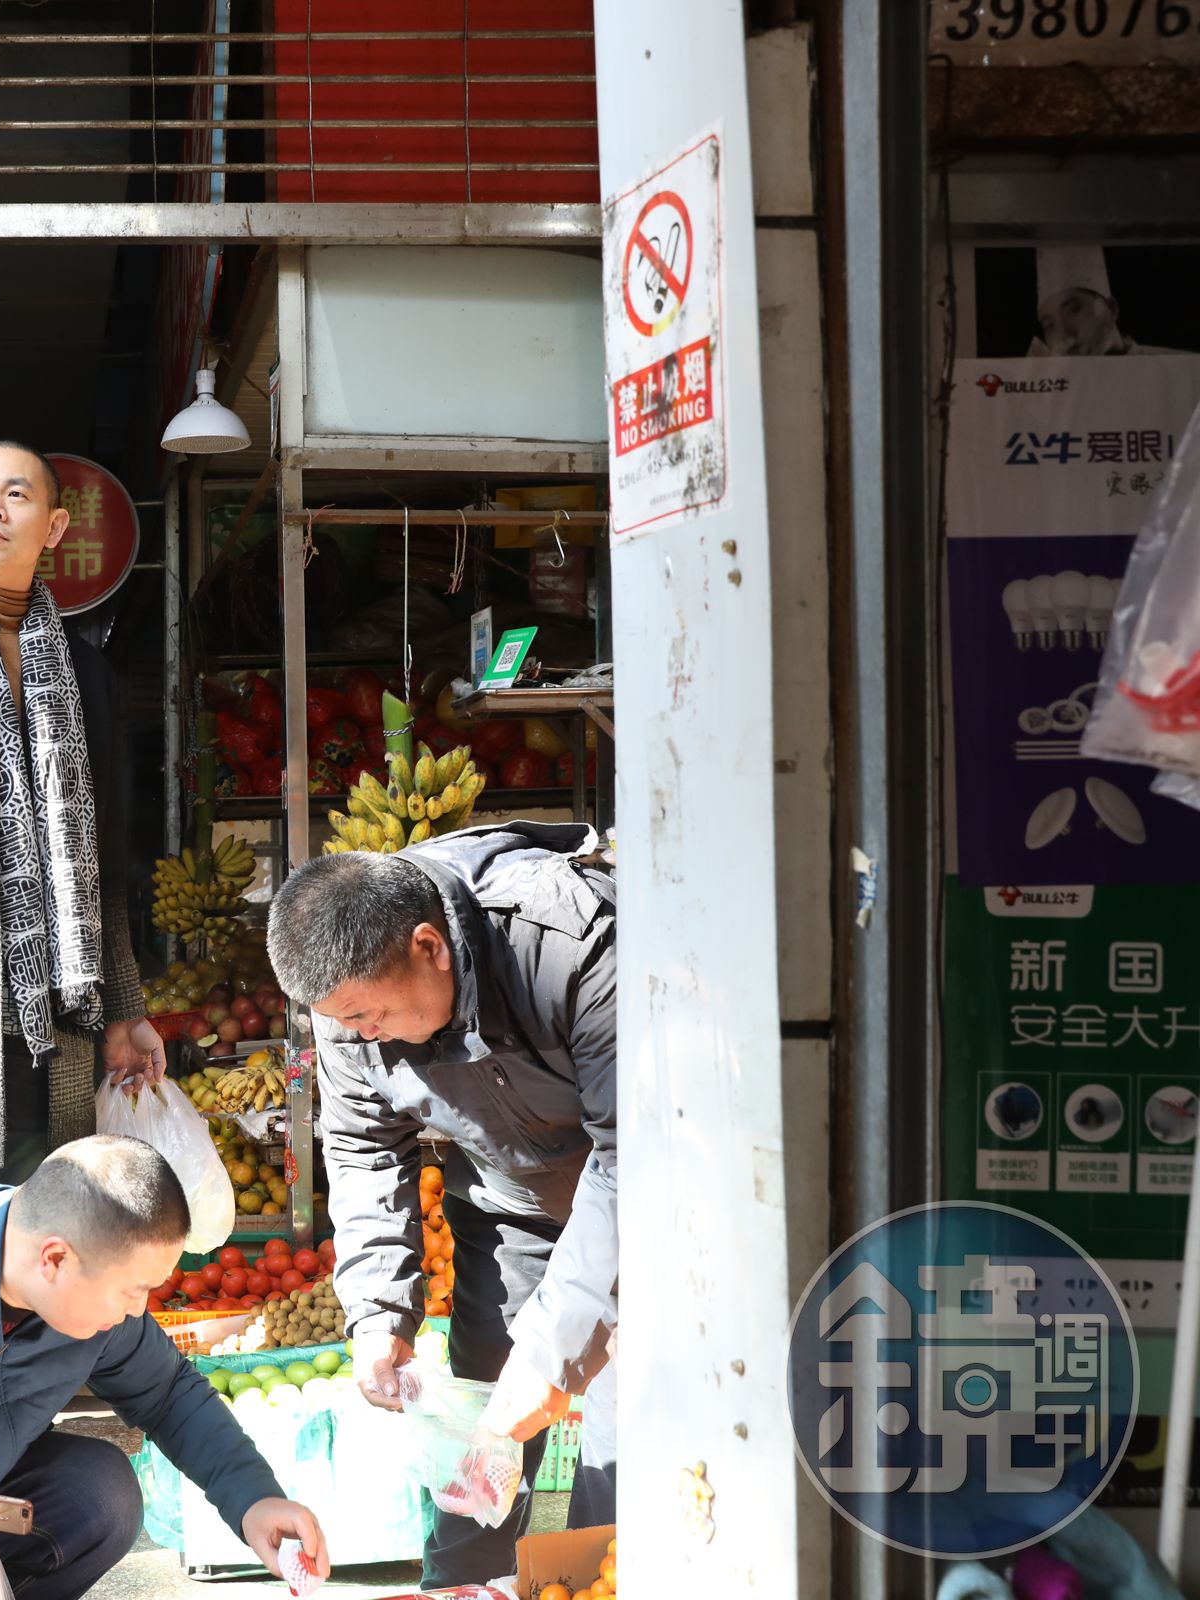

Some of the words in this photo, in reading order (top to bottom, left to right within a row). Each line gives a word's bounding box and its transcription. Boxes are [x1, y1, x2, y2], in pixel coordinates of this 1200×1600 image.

[945, 0, 1200, 40] 398076
[620, 425, 639, 450] NO
[640, 397, 706, 441] SMOKING
